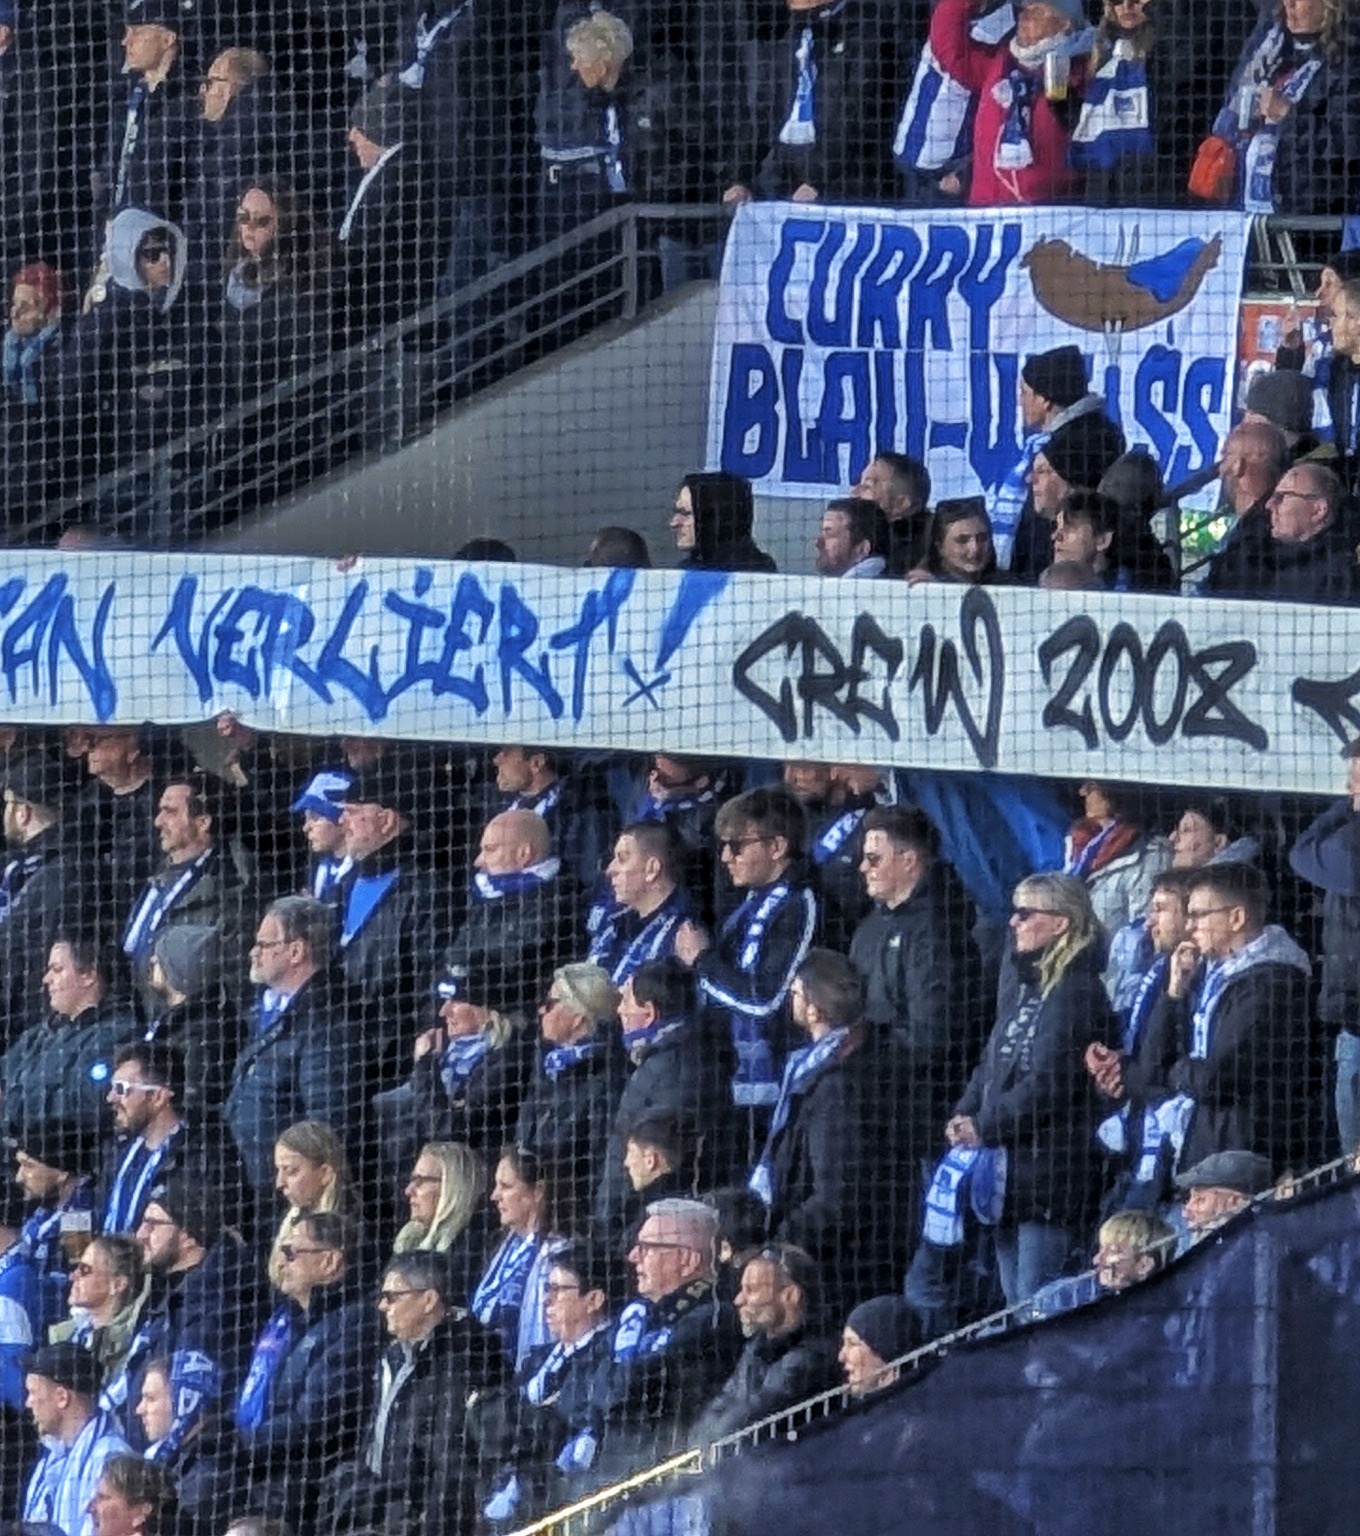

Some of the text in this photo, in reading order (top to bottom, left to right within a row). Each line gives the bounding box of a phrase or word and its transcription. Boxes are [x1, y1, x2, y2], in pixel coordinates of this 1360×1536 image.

[766, 219, 1022, 350] CURRY
[733, 585, 1007, 770] CREW
[1037, 613, 1270, 753] 2008
